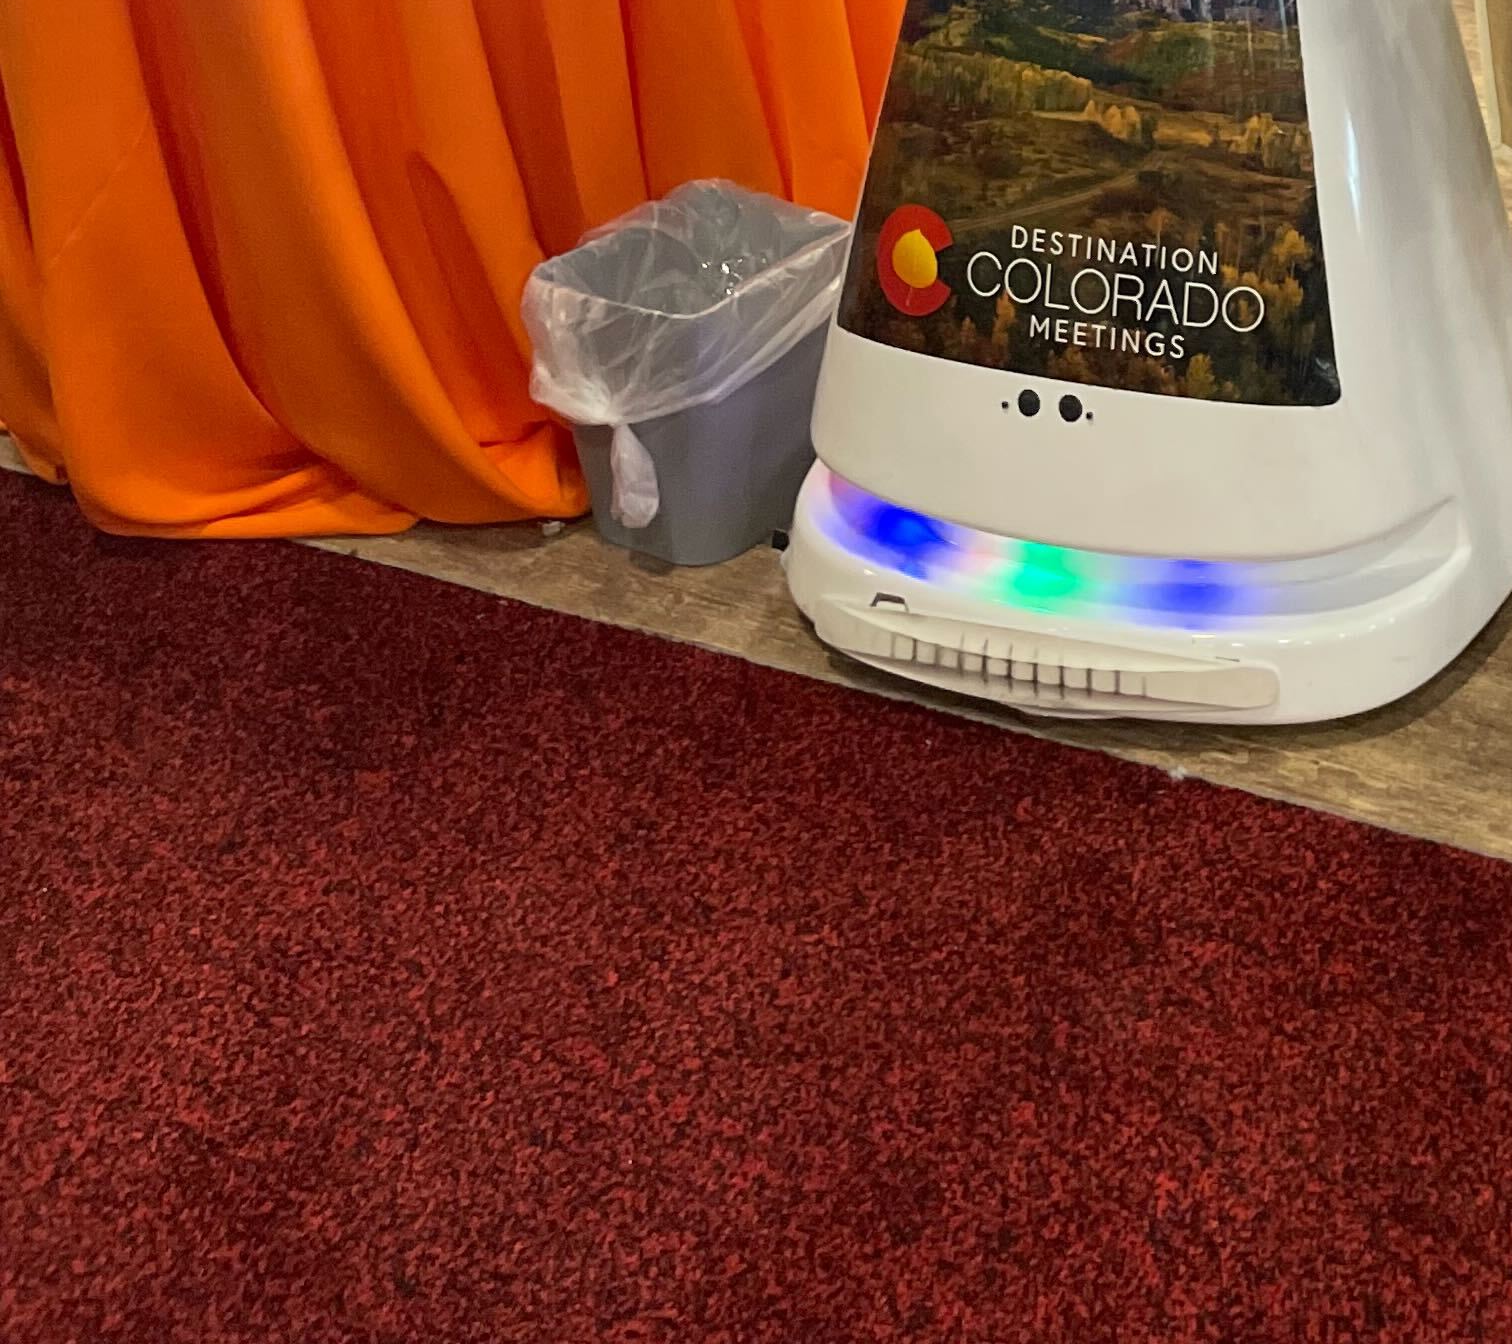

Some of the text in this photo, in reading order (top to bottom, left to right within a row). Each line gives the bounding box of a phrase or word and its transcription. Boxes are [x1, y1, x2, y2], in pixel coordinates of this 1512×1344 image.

[1011, 224, 1218, 275] DESTINATION
[966, 251, 1265, 332] COLORADO
[1029, 314, 1185, 359] MEETINGS
